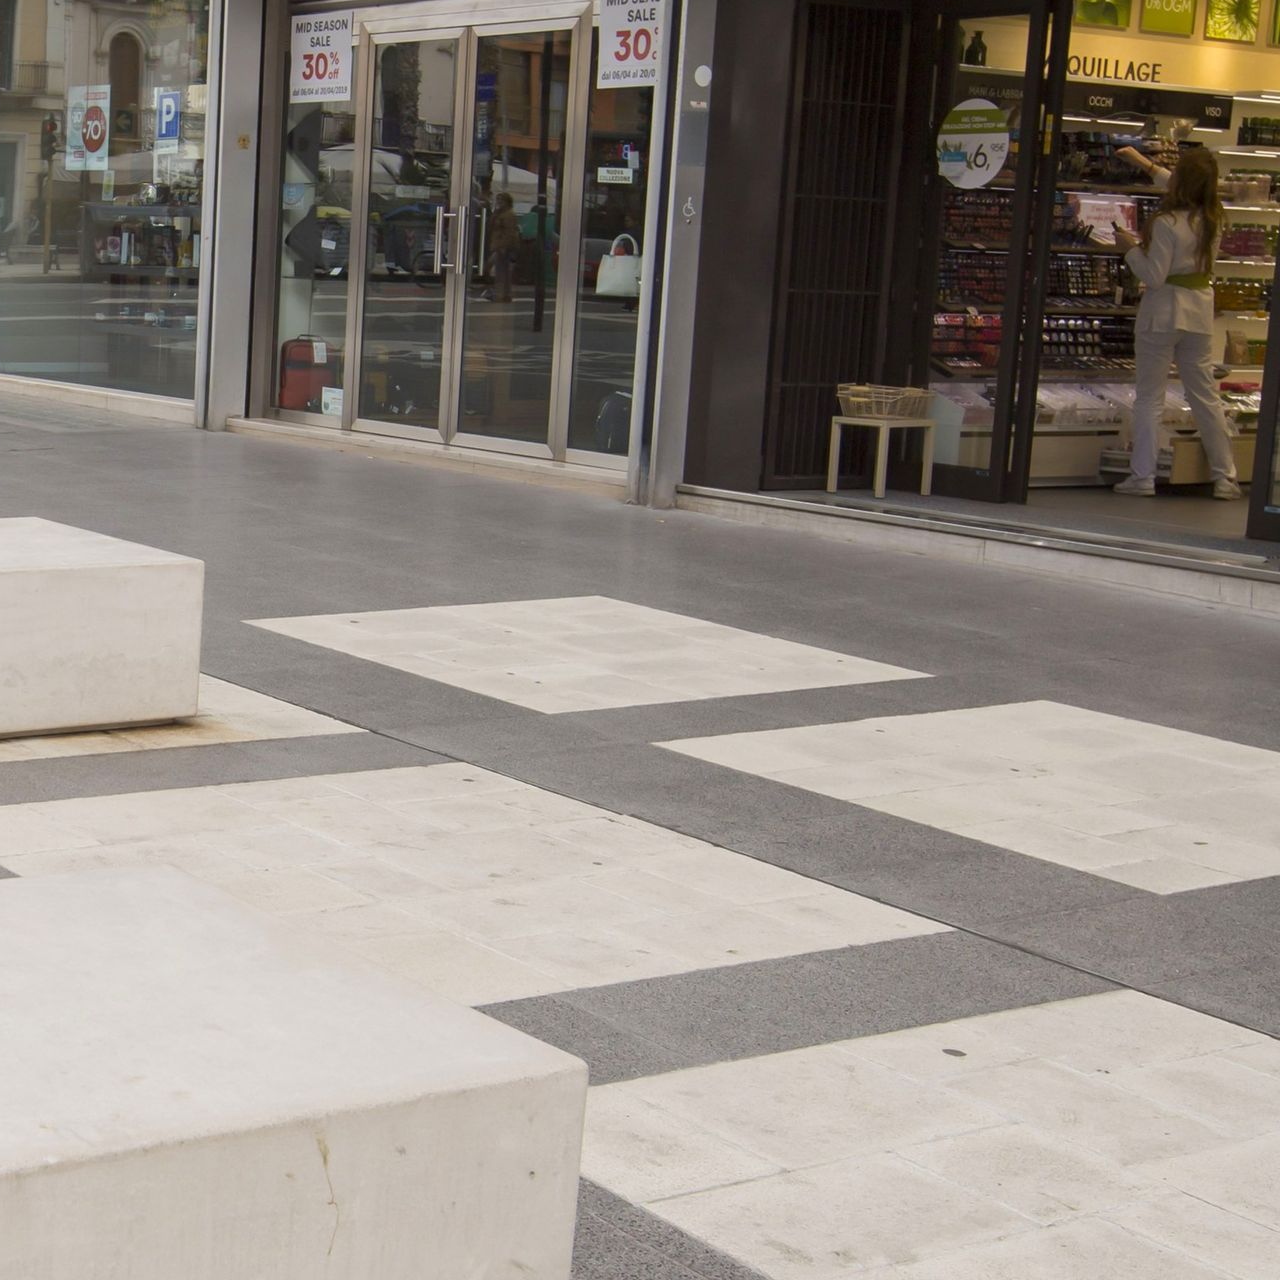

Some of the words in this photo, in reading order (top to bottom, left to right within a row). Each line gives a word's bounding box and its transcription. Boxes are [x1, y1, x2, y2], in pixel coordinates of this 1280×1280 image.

[627, 8, 657, 23] SALE
[295, 22, 312, 34] MID
[313, 19, 349, 33] SEASON
[310, 35, 331, 48] SALE
[328, 68, 339, 80] off
[1088, 95, 1114, 108] OCCHI
[1204, 105, 1222, 118] VISO
